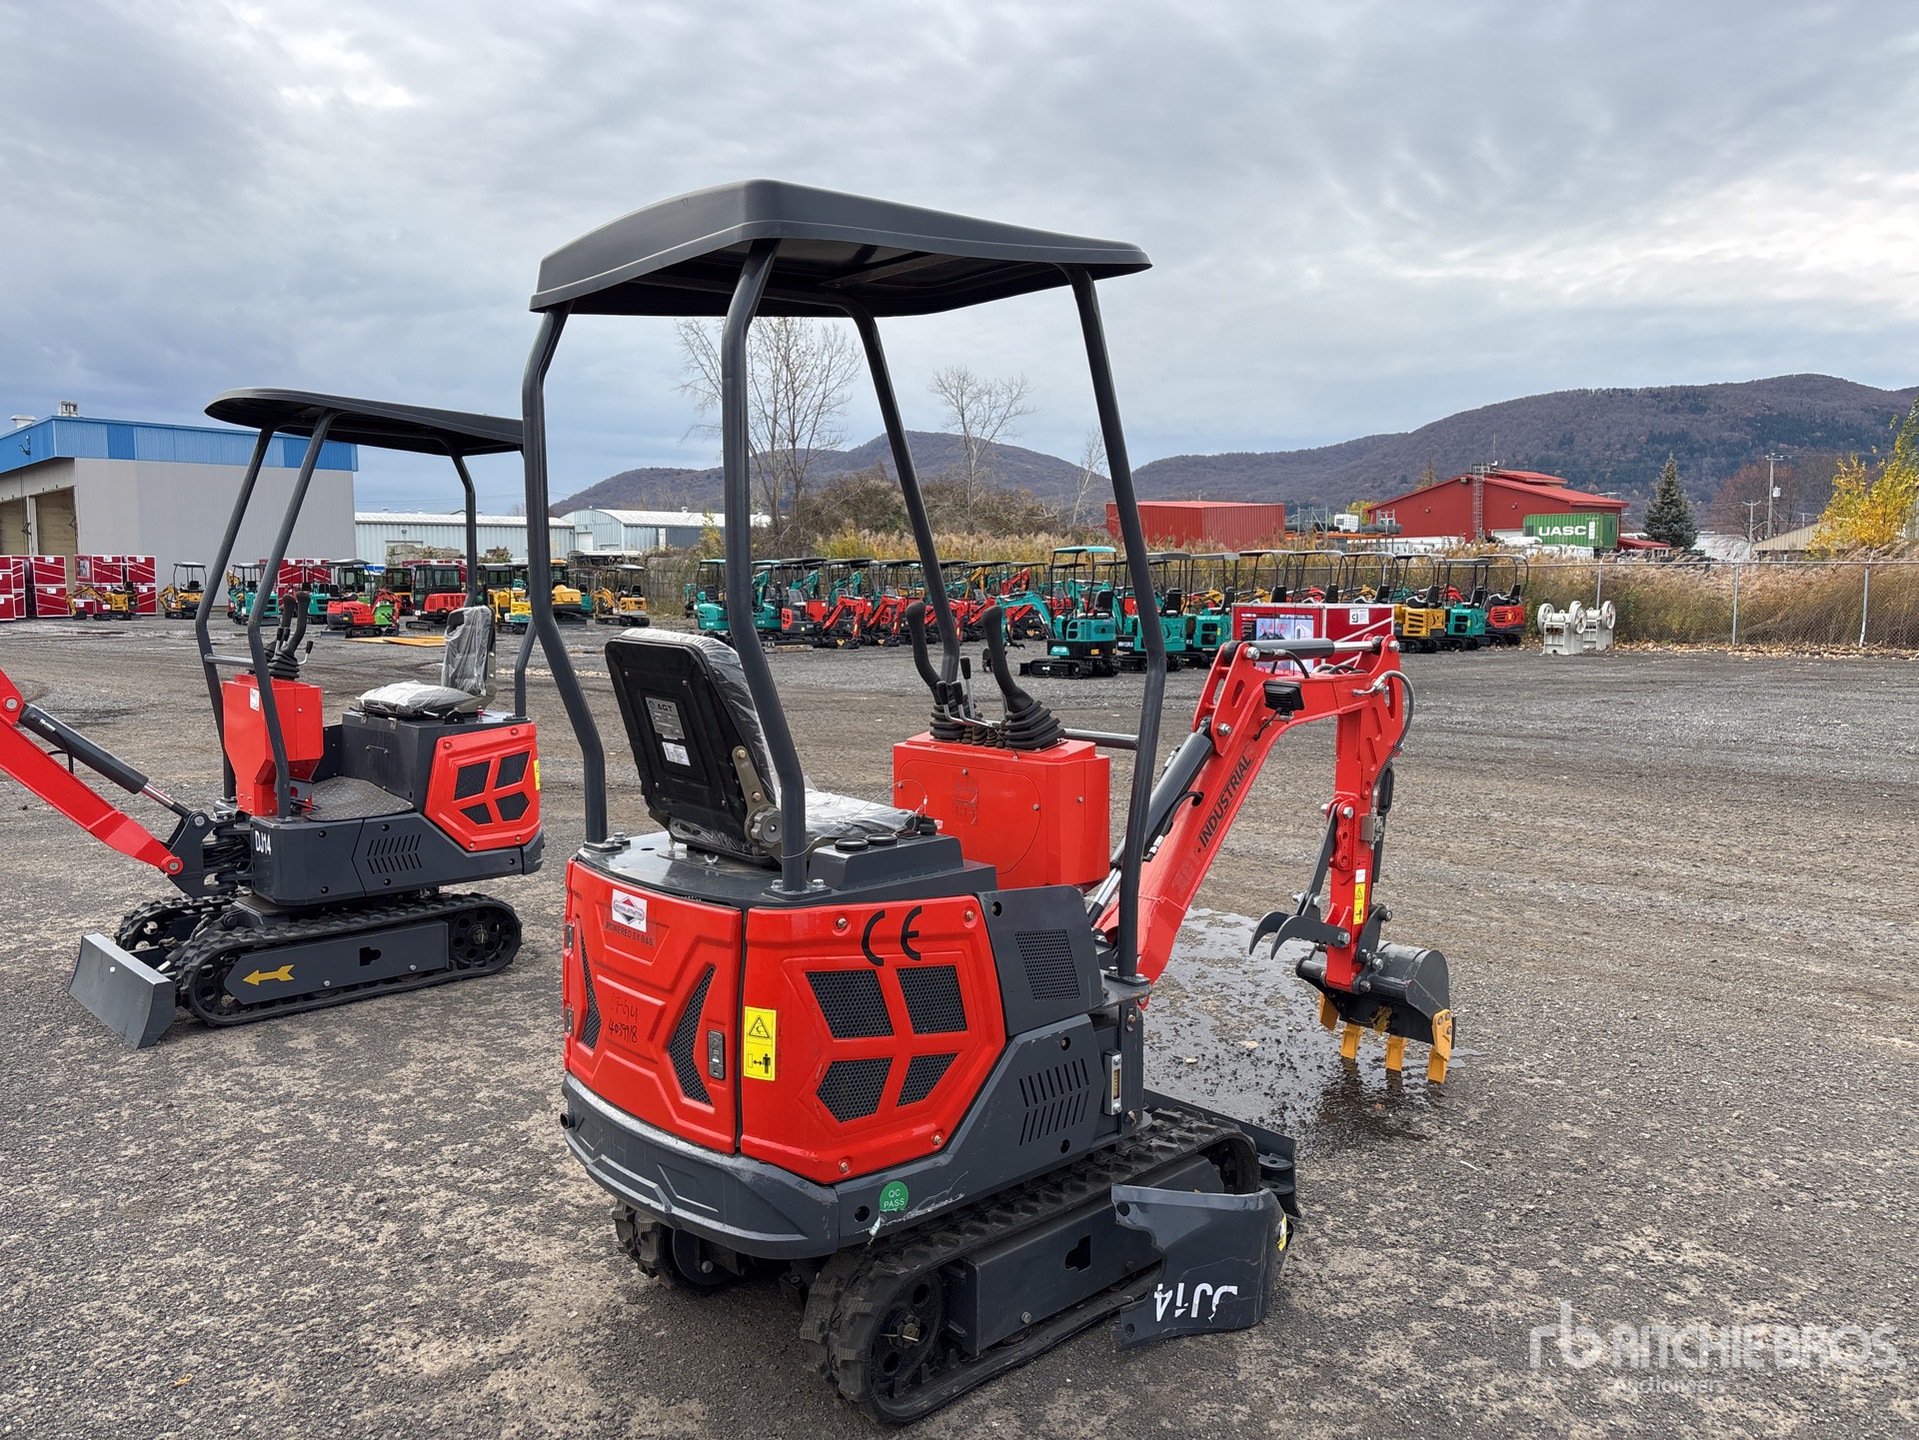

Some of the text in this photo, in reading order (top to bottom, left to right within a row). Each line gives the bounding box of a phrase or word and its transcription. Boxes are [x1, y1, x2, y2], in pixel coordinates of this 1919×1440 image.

[1538, 525, 1587, 537] UASC
[656, 703, 674, 712] AGT
[1197, 754, 1253, 849] INDUSTRIAL
[255, 830, 272, 855] DJ14
[605, 920, 632, 938] POWERED
[632, 931, 641, 941] BY
[888, 1188, 901, 1198] QC
[883, 1198, 905, 1208] PASS
